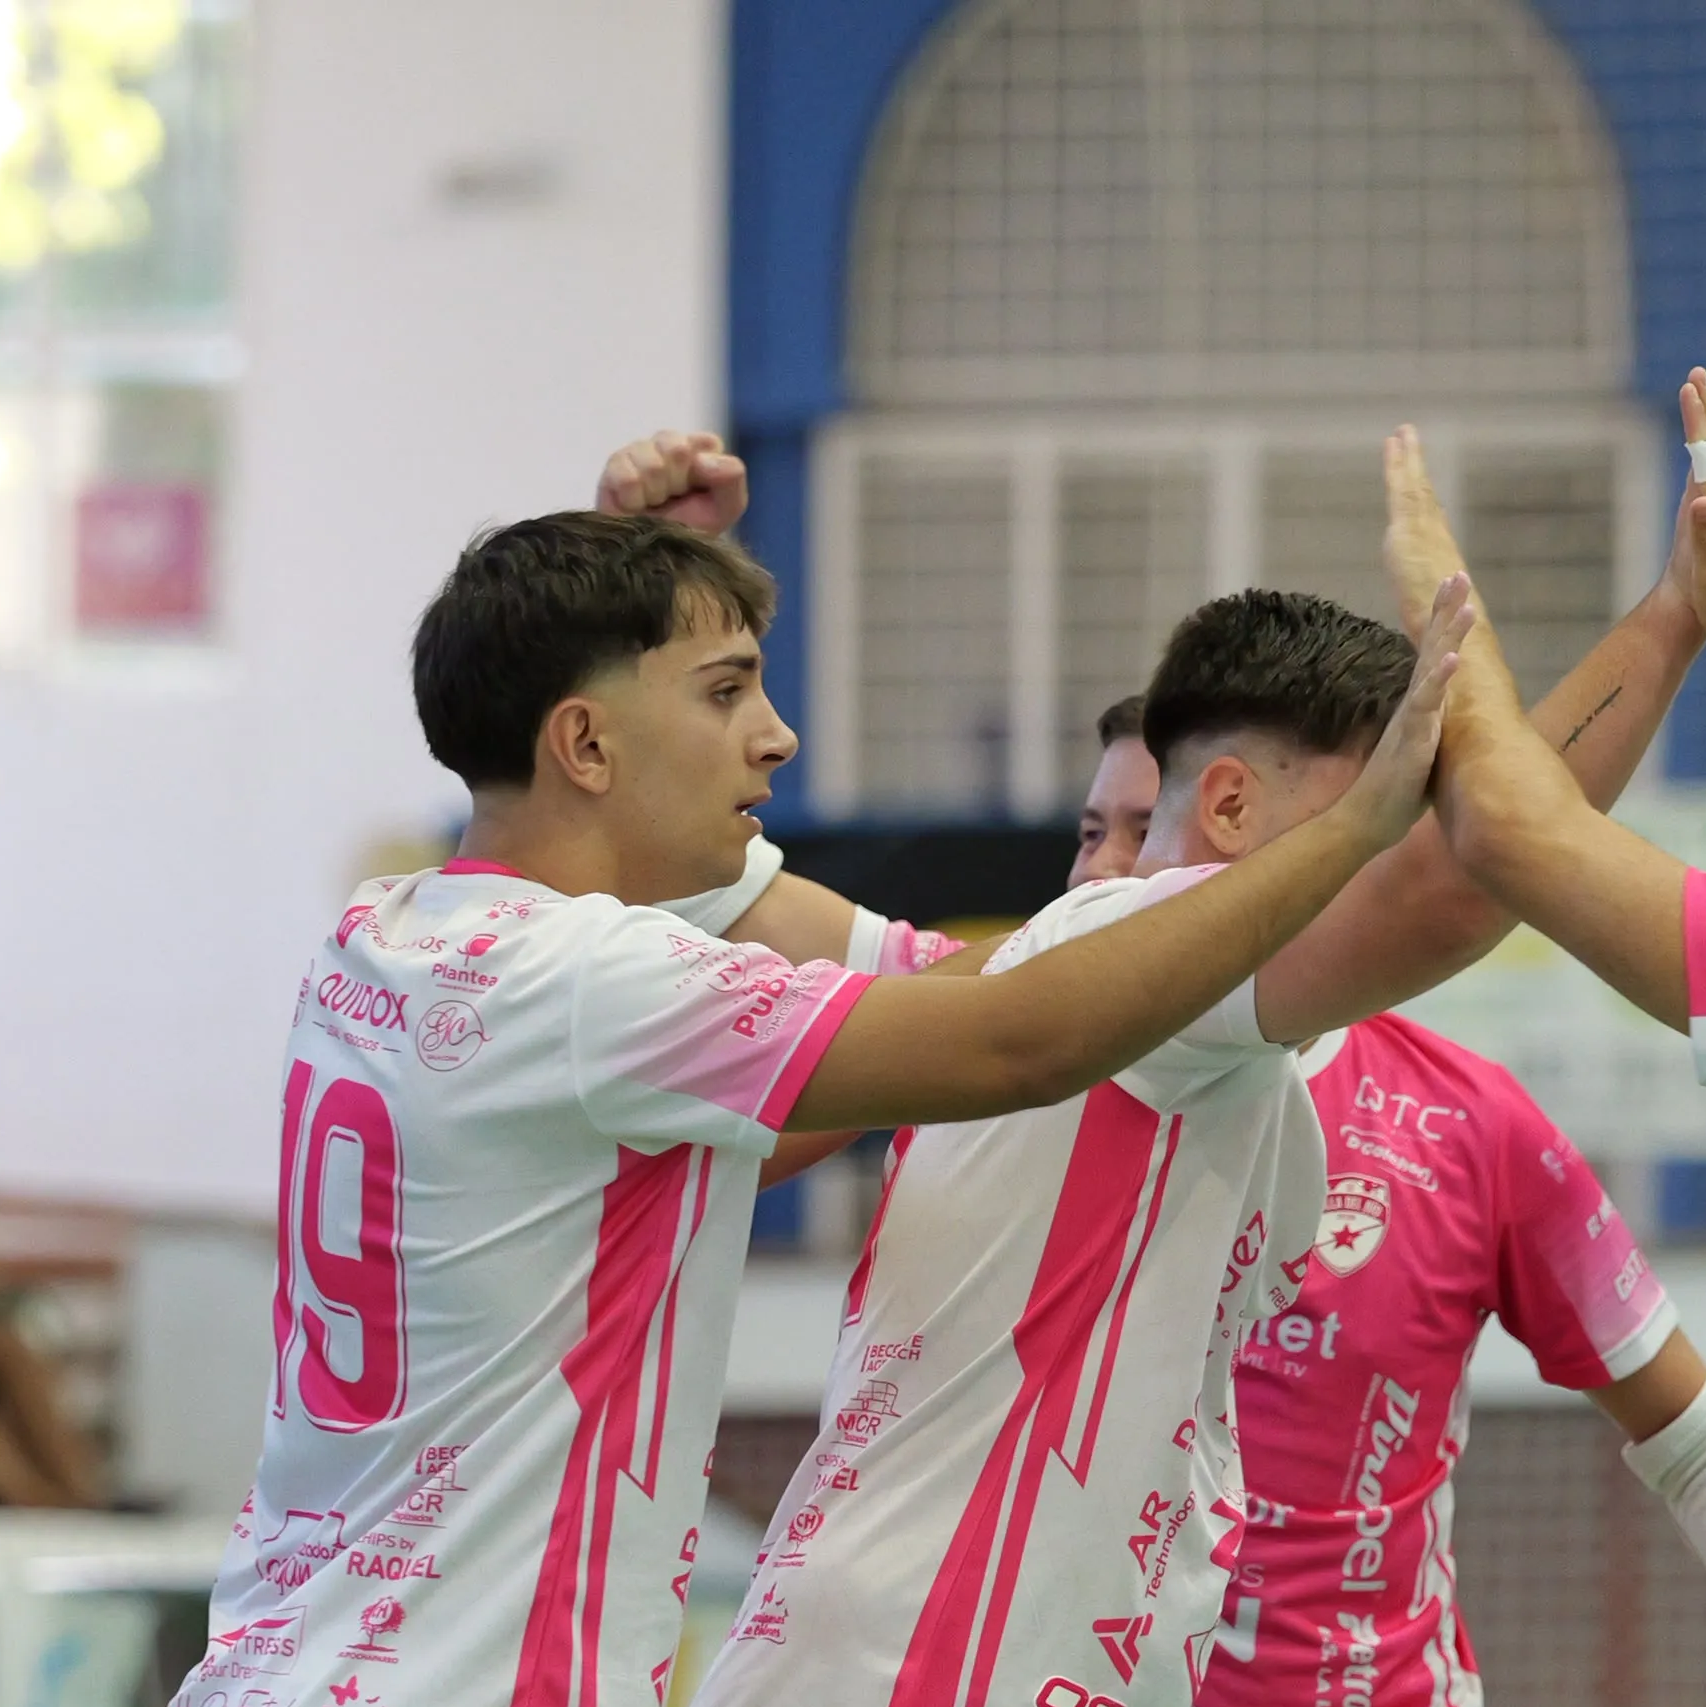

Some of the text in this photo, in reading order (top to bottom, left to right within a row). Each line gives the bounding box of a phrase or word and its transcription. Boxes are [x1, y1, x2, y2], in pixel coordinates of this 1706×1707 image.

[317, 972, 410, 1032] QUIDOX
[431, 963, 499, 987] Plantea
[272, 1058, 408, 1434] 19
[836, 1412, 881, 1436] MCR
[1144, 1489, 1198, 1600] Technolog
